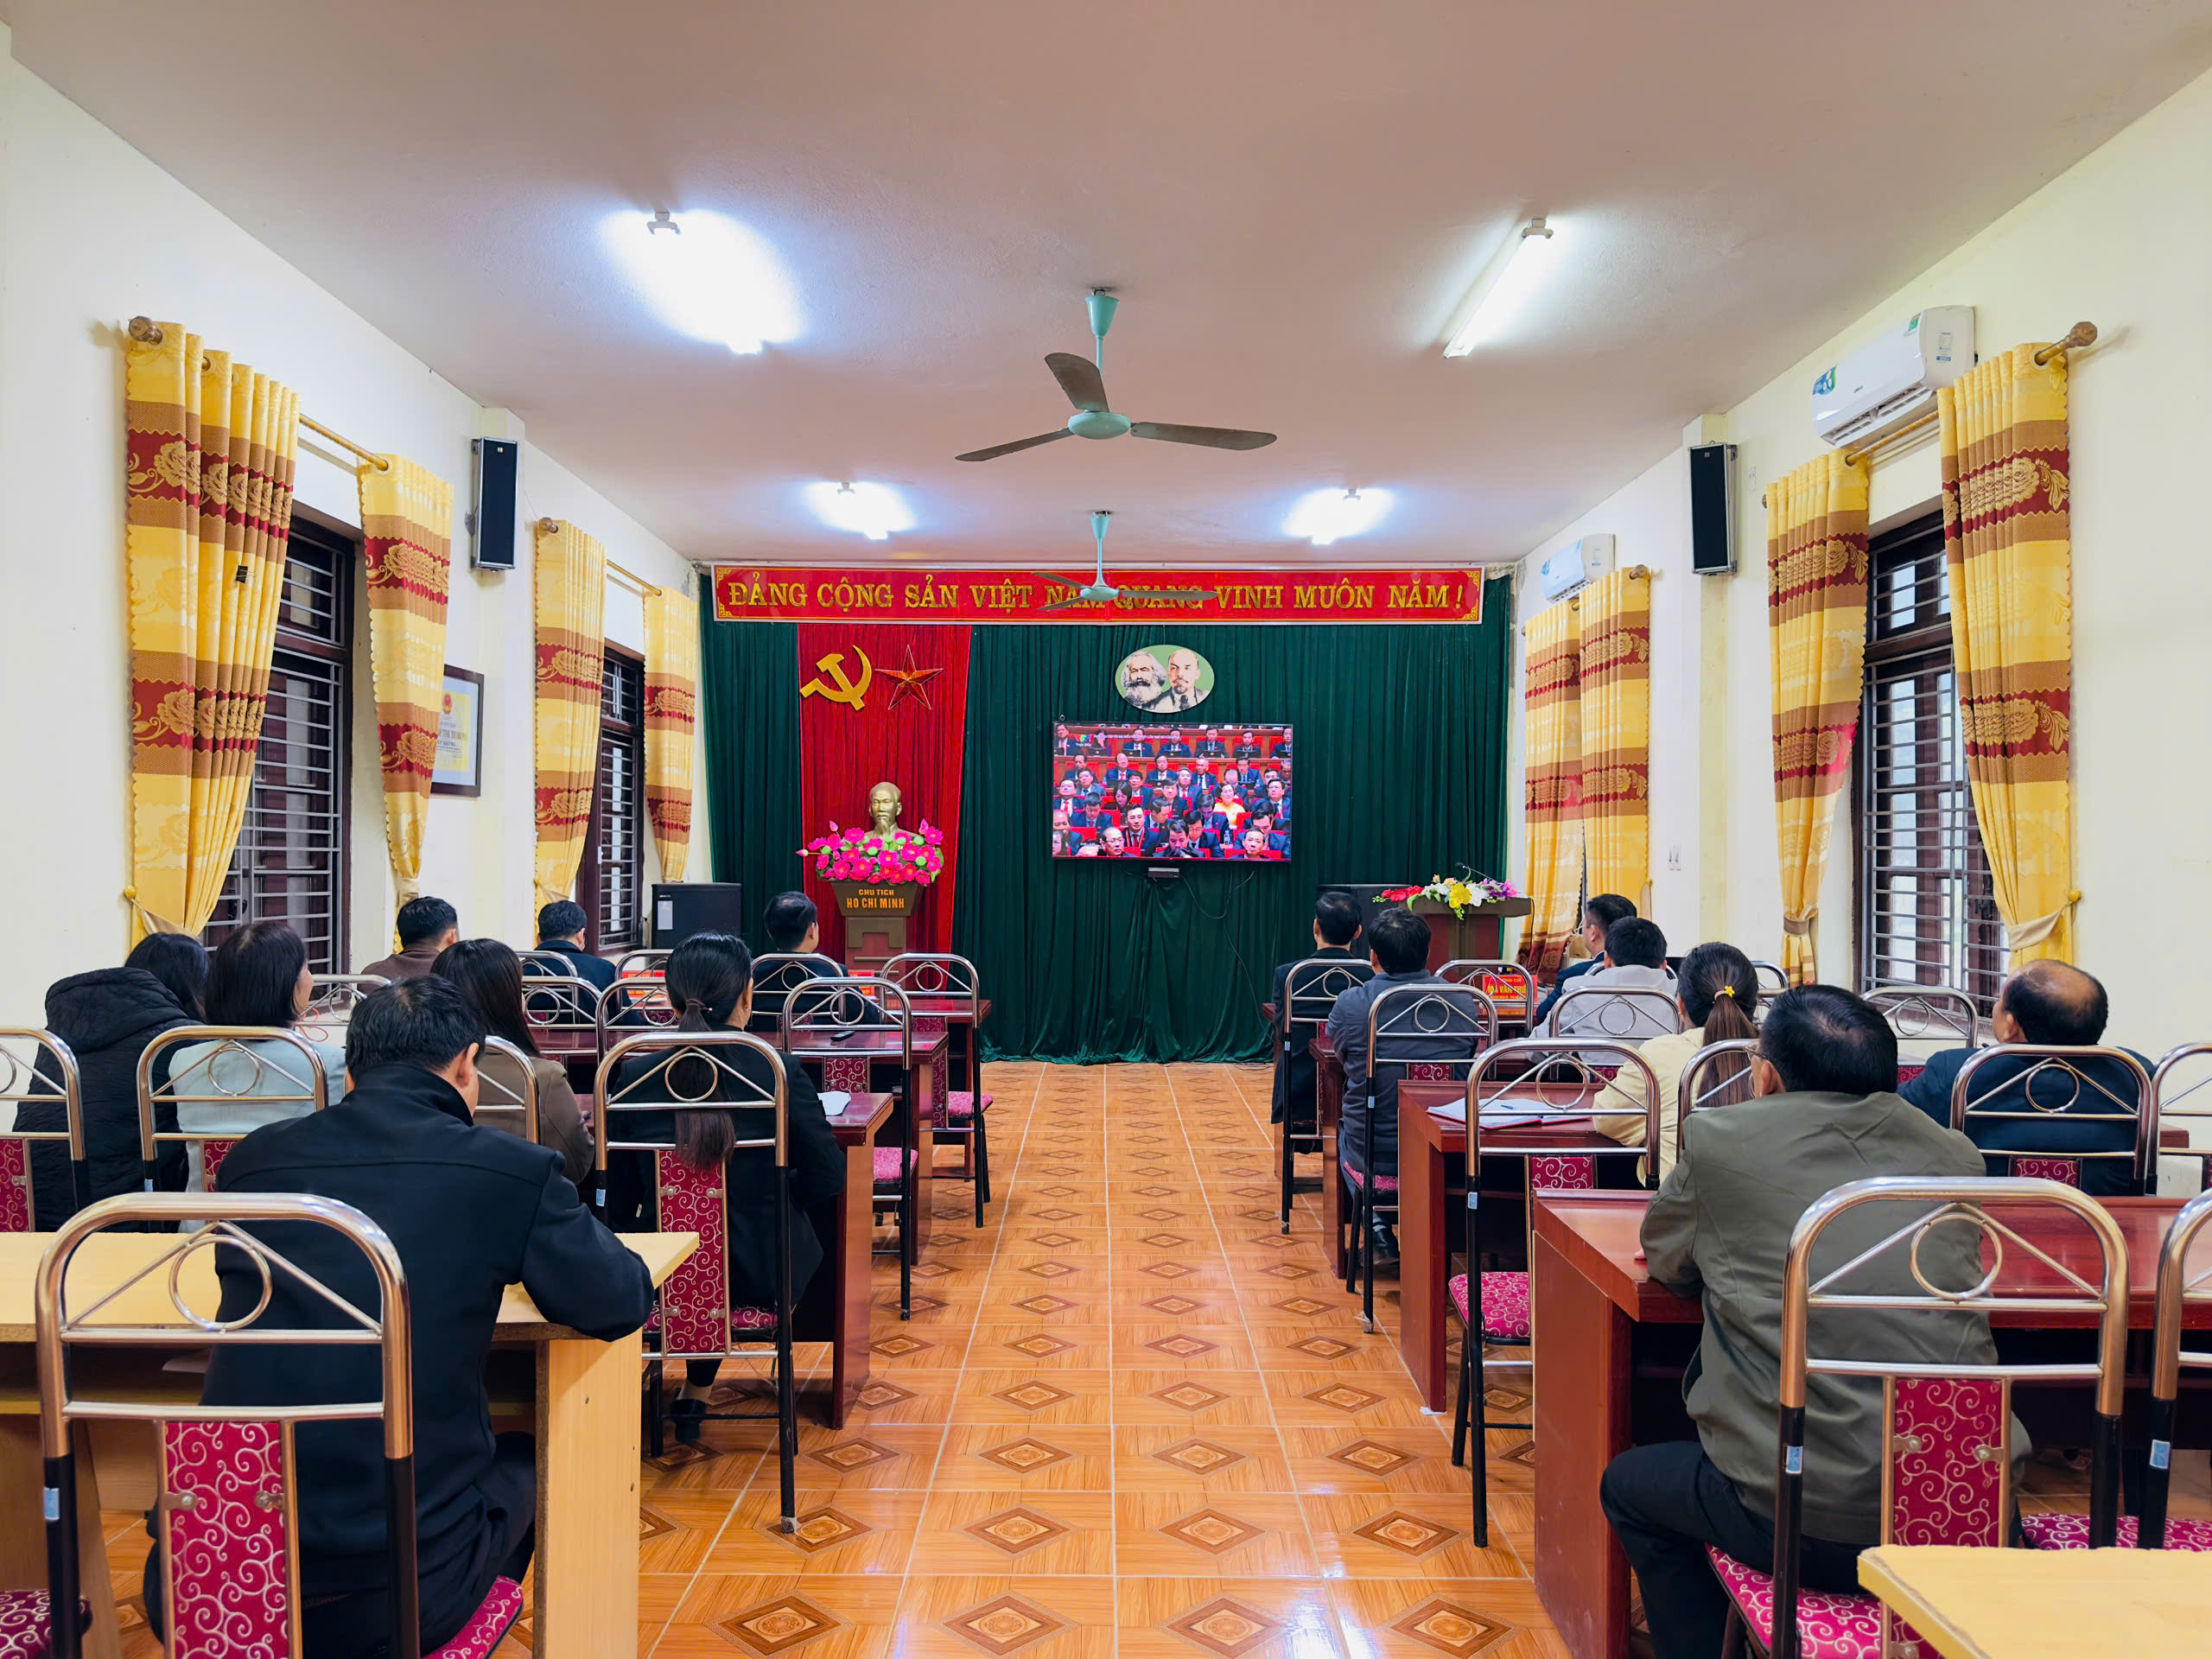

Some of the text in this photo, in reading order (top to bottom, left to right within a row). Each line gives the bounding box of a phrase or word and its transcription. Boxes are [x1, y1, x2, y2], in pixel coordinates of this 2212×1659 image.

[728, 571, 808, 607] ĐẢNG
[817, 576, 894, 613] CỘNG
[905, 574, 959, 608] SẢN
[969, 578, 1033, 614] VIỆT
[1214, 585, 1285, 609] VINH
[1293, 577, 1376, 609] MUÔN
[880, 898, 905, 908] MINH
